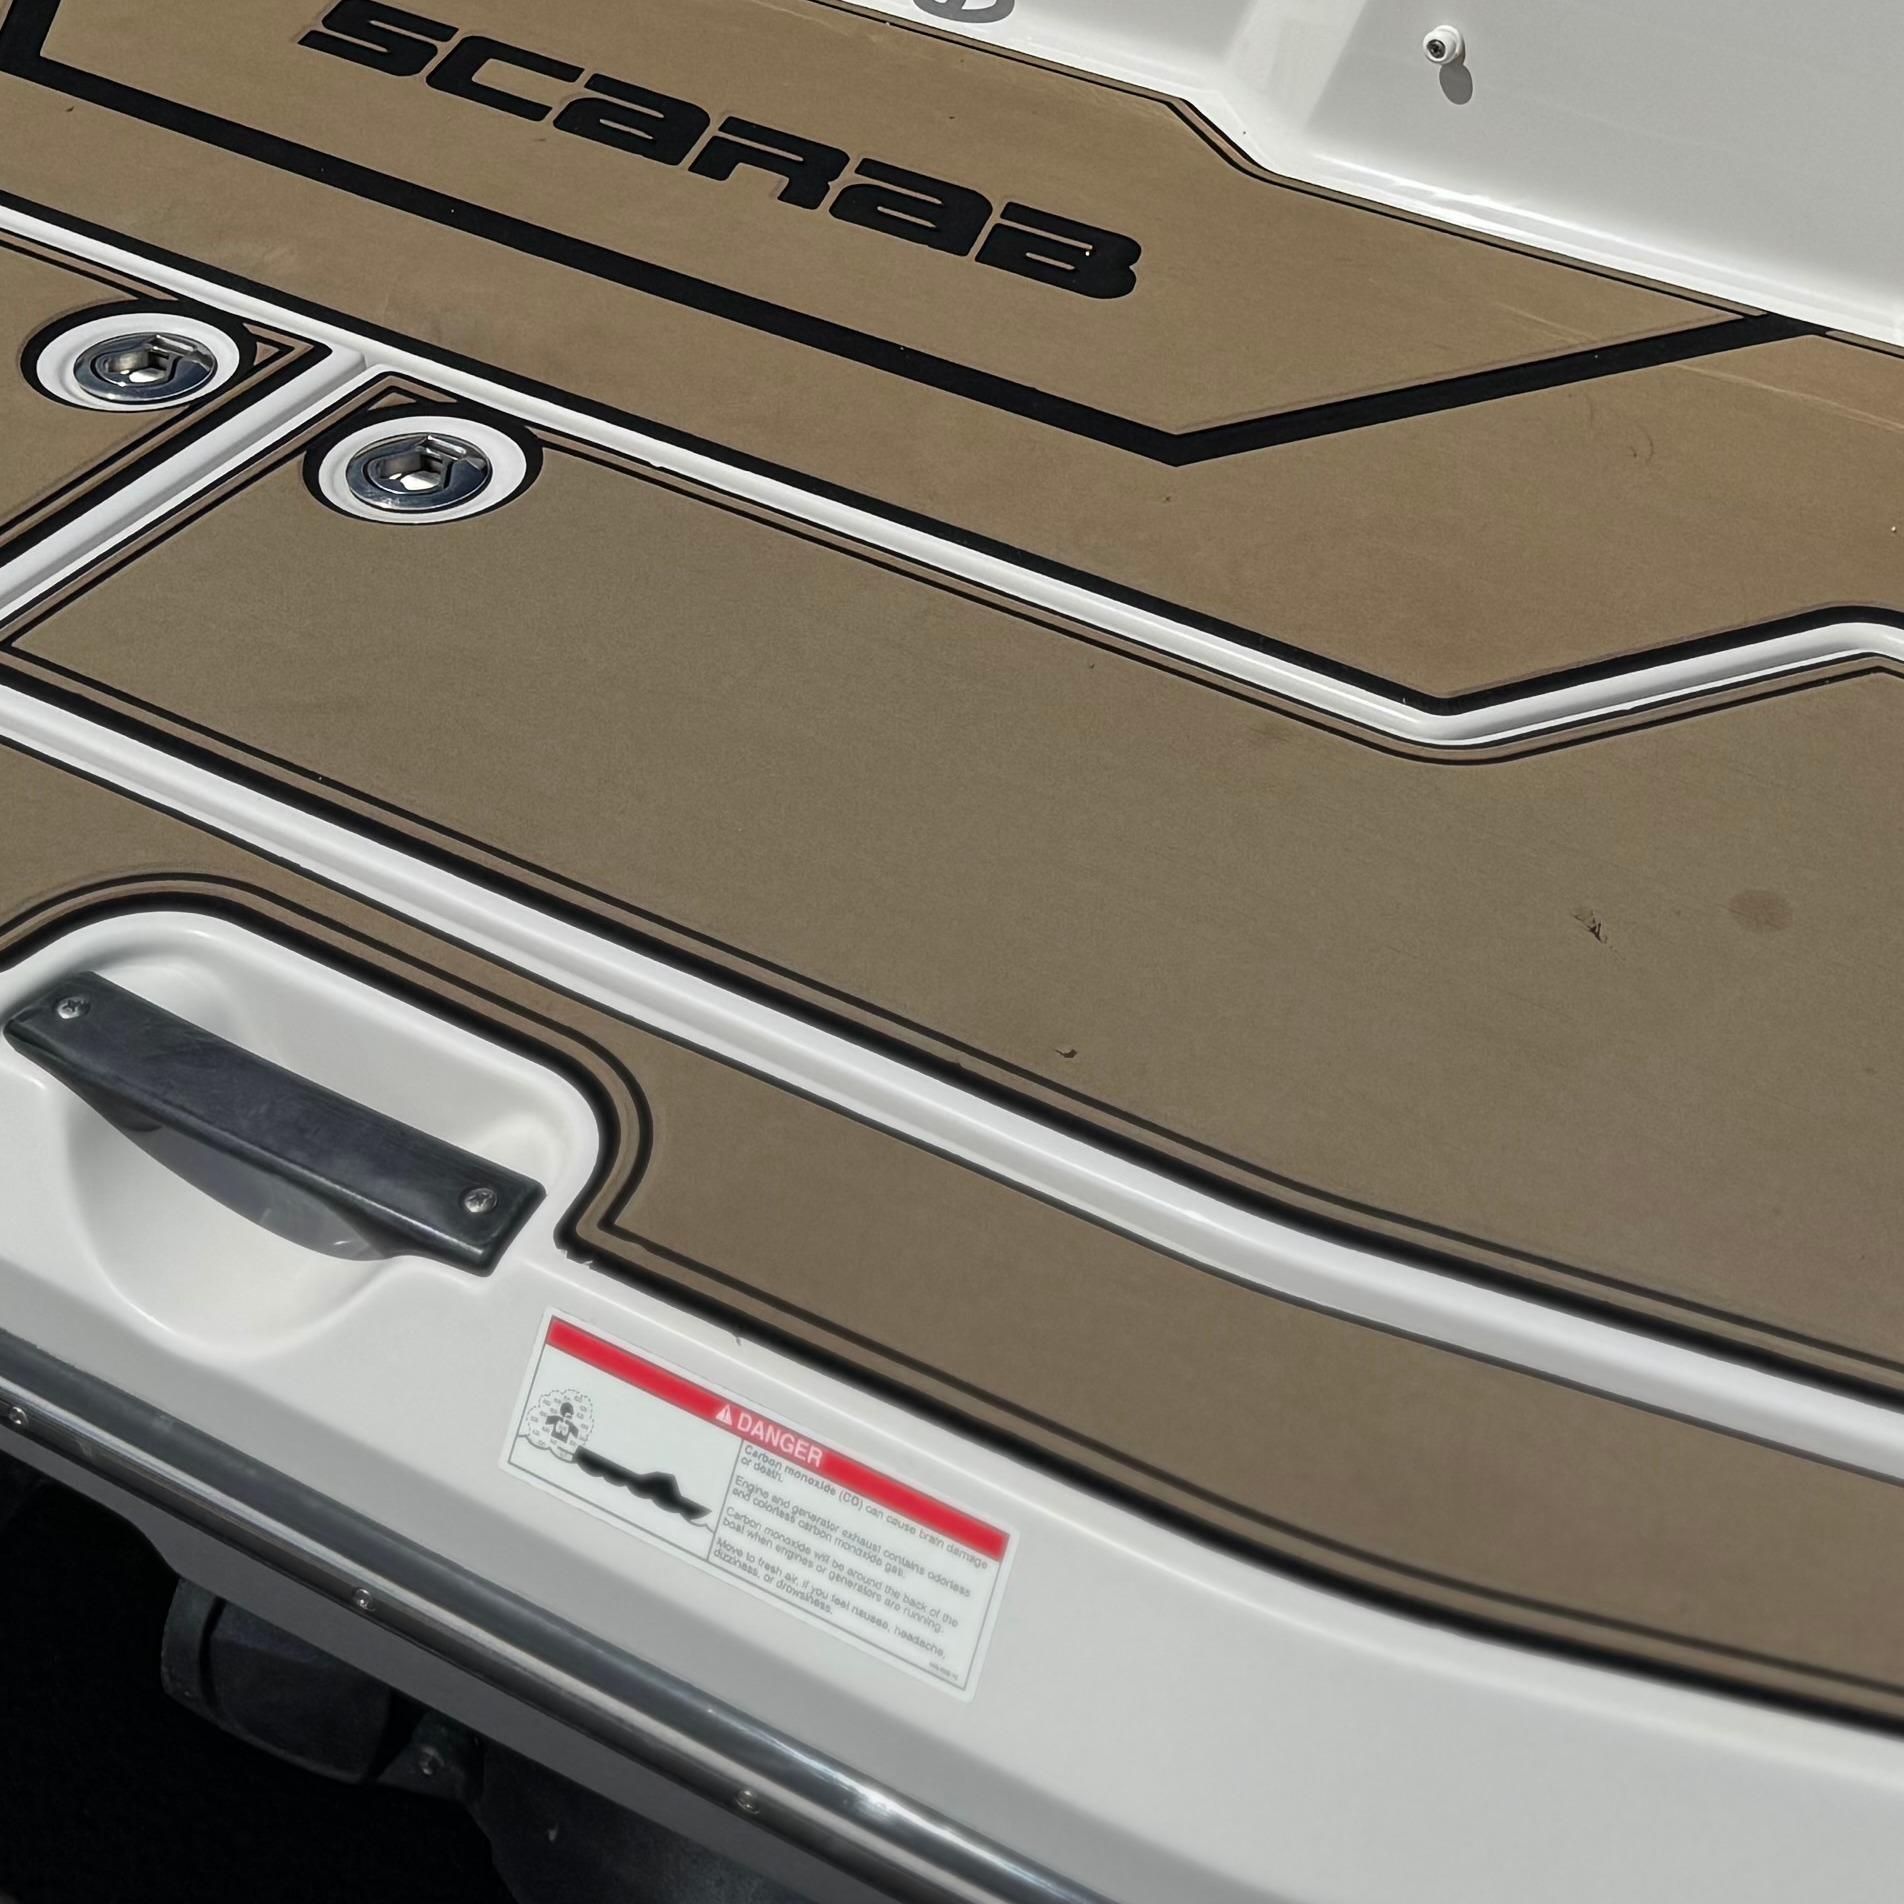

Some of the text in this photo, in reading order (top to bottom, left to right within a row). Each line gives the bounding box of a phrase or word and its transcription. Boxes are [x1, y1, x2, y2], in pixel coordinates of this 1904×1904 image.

[737, 1412, 825, 1468] DANGER
[740, 1455, 784, 1483] or death.
[731, 1485, 751, 1503] and
[751, 1495, 796, 1525] colorless
[796, 1517, 833, 1542] carbon
[833, 1535, 883, 1567] monoxide
[734, 1474, 972, 1599] Engine and generator exhaust contains odorless
[743, 1443, 989, 1572] Carbon monoxide (CO) can cause brain damage
[715, 1536, 744, 1558] Move
[744, 1551, 757, 1564] to
[757, 1556, 783, 1577] fresh
[810, 1585, 830, 1603] you
[830, 1593, 850, 1611] feel
[722, 1515, 745, 1535] boat
[745, 1527, 774, 1549] when
[773, 1542, 814, 1571] engines
[815, 1562, 827, 1575] or
[827, 1568, 882, 1604] generators
[883, 1596, 902, 1612] are
[725, 1505, 960, 1629] Carbon monoxide will be around the back of the
